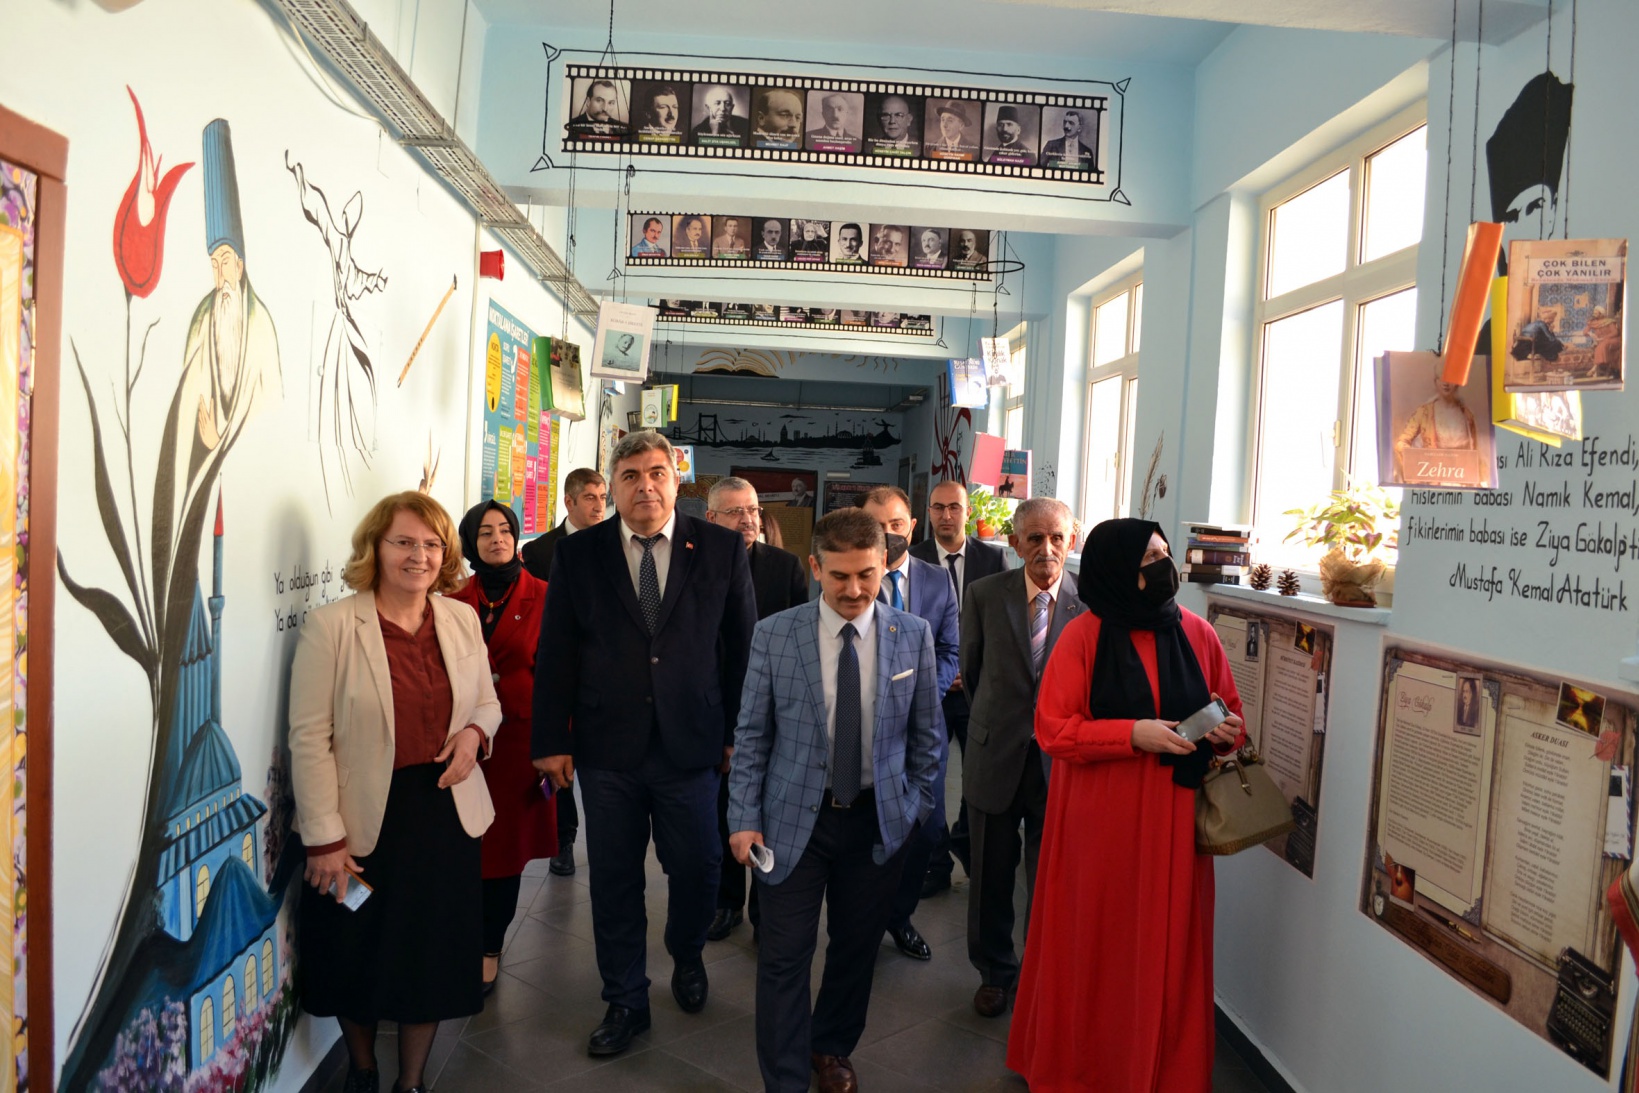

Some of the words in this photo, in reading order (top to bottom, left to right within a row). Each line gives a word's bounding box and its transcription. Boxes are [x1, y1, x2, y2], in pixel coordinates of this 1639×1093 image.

[1537, 270, 1560, 278] ÇOK
[1565, 269, 1611, 277] YANILIR
[1543, 260, 1566, 268] ÇOK
[1417, 461, 1465, 479] Zehra
[1515, 441, 1533, 468] Ali
[1539, 441, 1573, 468] Rıza
[1580, 434, 1639, 477] Efendi,
[1522, 480, 1571, 508] Namık
[1583, 479, 1639, 517] Kemal,
[1405, 515, 1465, 546] fikirlerimin
[1468, 517, 1505, 545] babası
[1510, 526, 1528, 547] ise
[1535, 520, 1571, 567] Ziya
[274, 571, 284, 595] Ya
[289, 564, 319, 603] olduğun
[1448, 562, 1504, 602] Mustafa
[1508, 568, 1555, 603] Kemal
[1556, 572, 1629, 612] Atatürk
[274, 607, 284, 632] Ya
[287, 603, 298, 629] da
